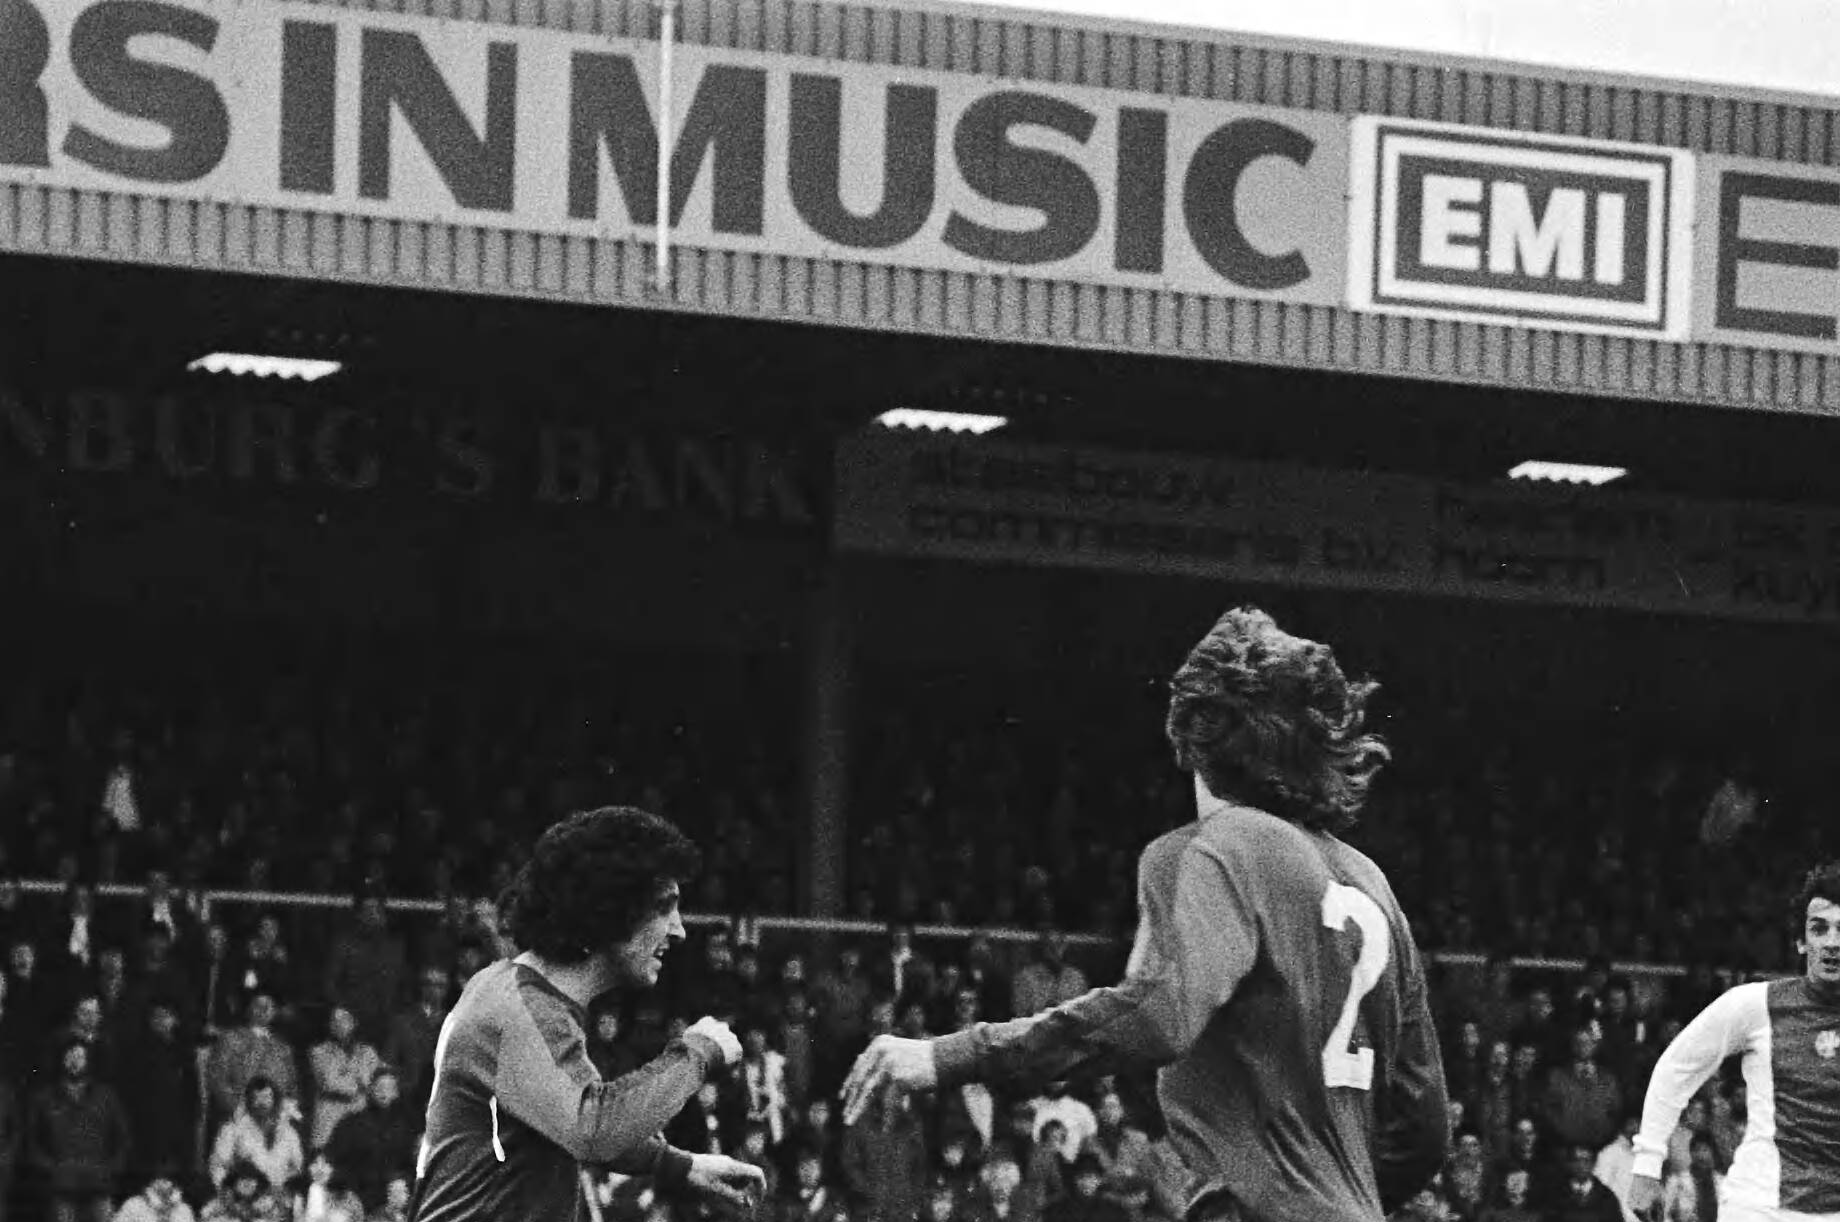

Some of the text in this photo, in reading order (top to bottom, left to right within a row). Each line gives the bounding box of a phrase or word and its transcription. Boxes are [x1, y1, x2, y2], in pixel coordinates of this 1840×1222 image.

[279, 18, 518, 212] IN
[567, 49, 1317, 292] MUSIC
[1419, 174, 1627, 287] EMI
[1321, 880, 1390, 1090] 2
